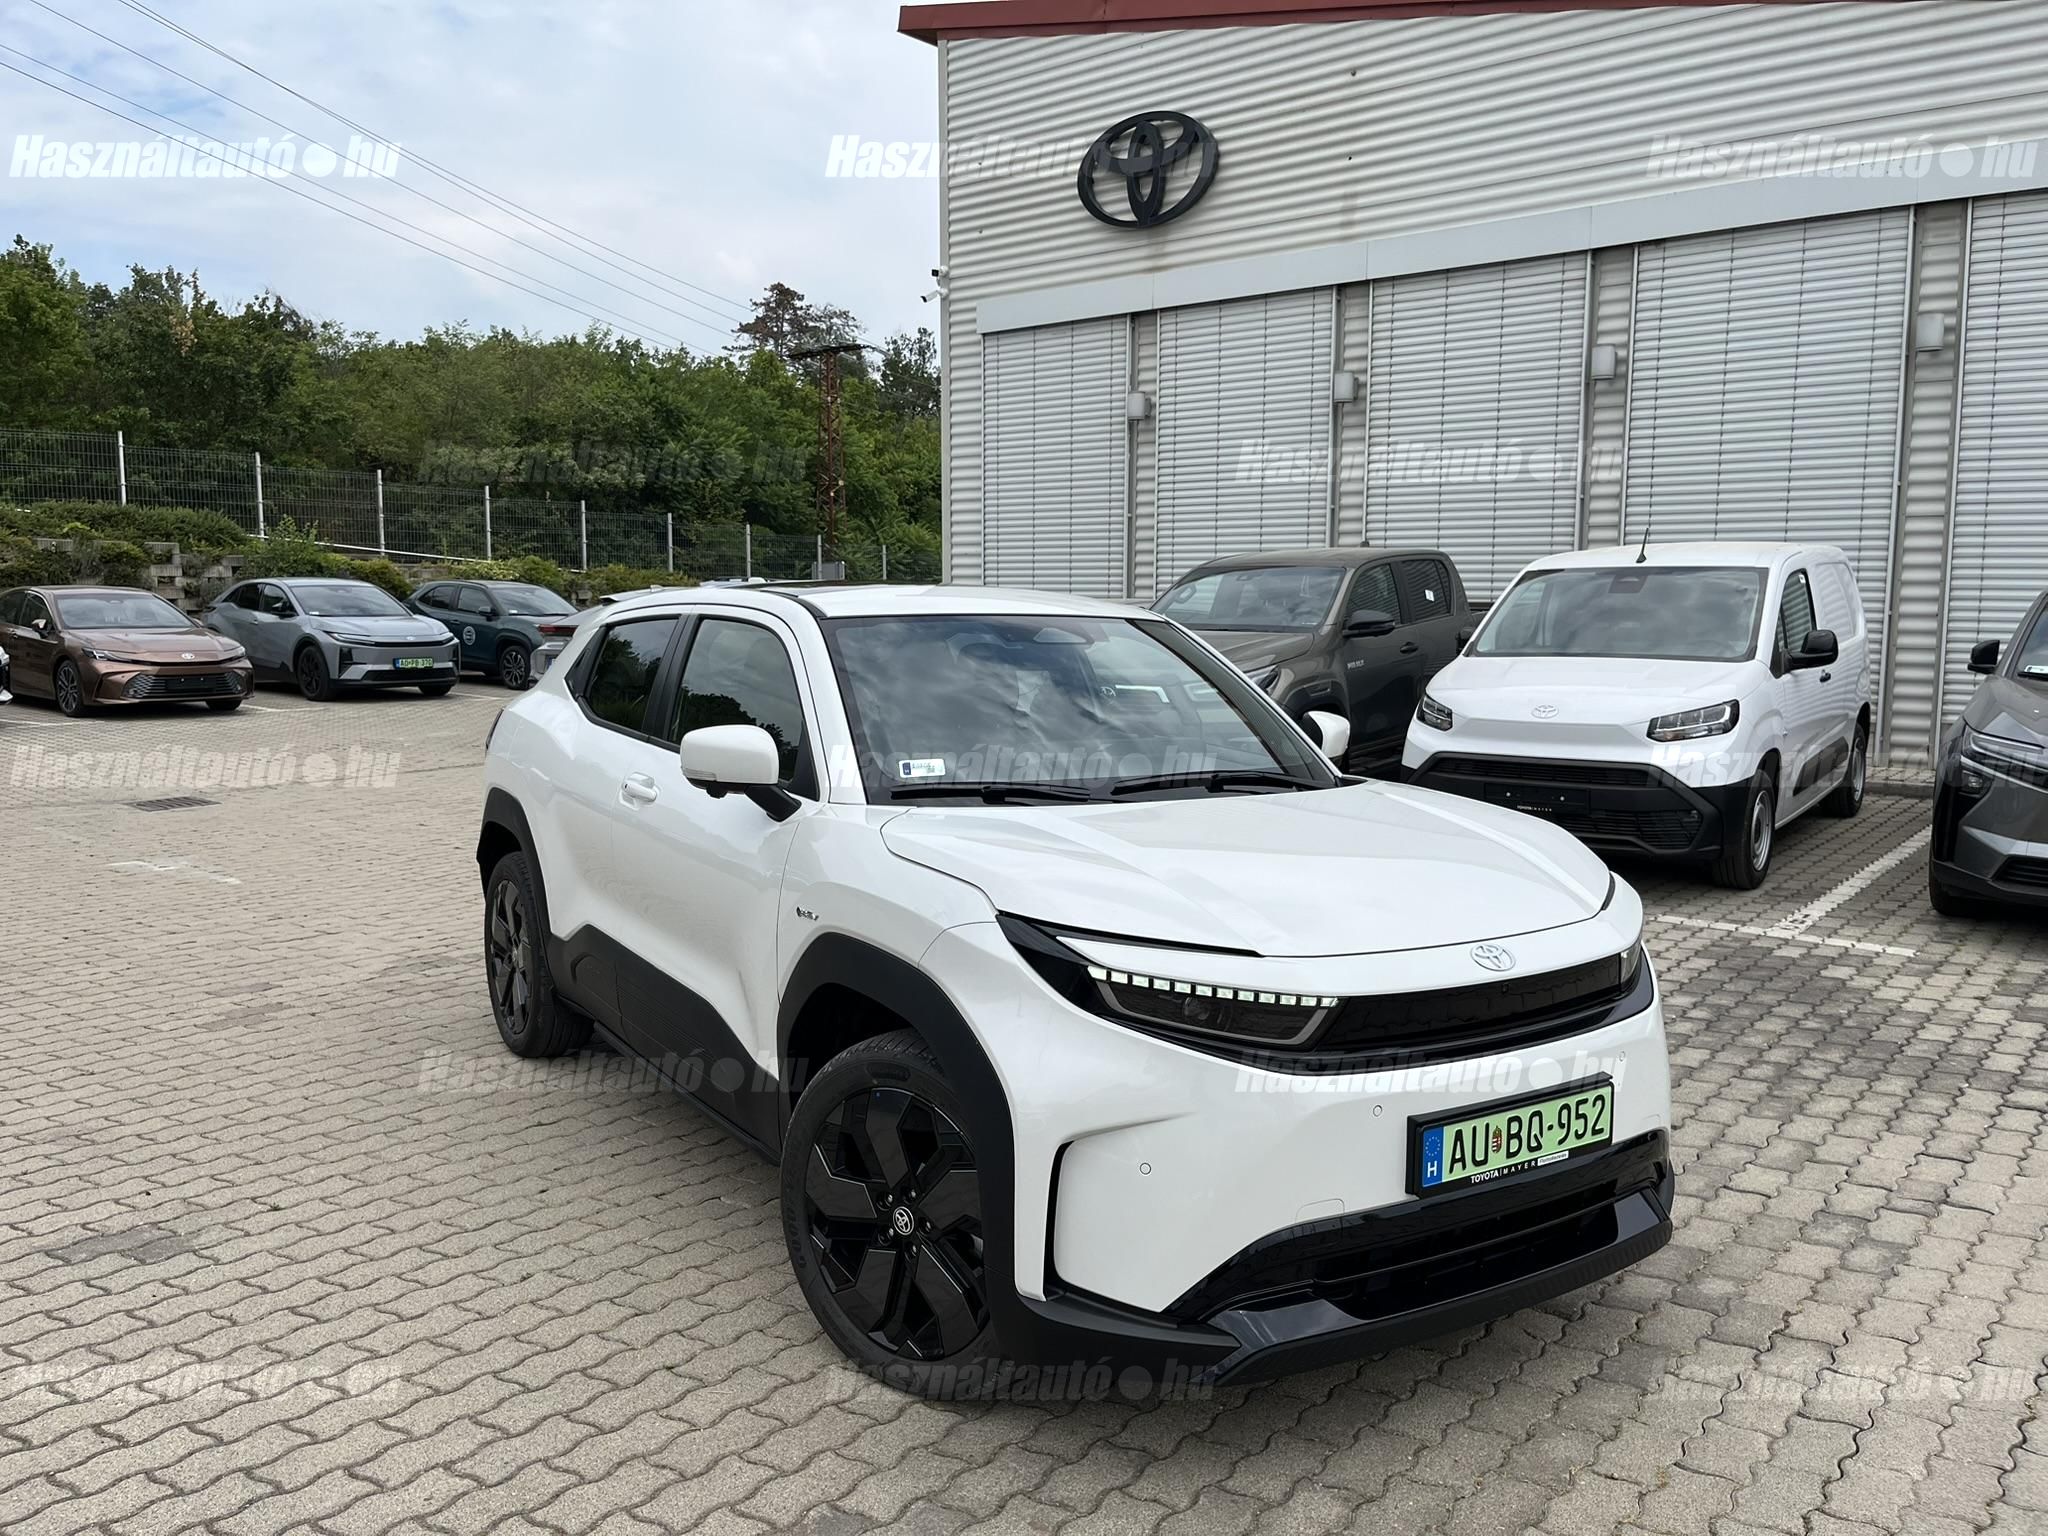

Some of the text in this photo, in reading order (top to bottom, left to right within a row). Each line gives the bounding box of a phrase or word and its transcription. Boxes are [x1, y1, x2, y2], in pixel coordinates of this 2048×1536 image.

[1449, 1094, 1607, 1174] AU BQ-952
[1427, 1160, 1438, 1178] H
[1470, 1161, 1536, 1184] TOYOTA MAYER
